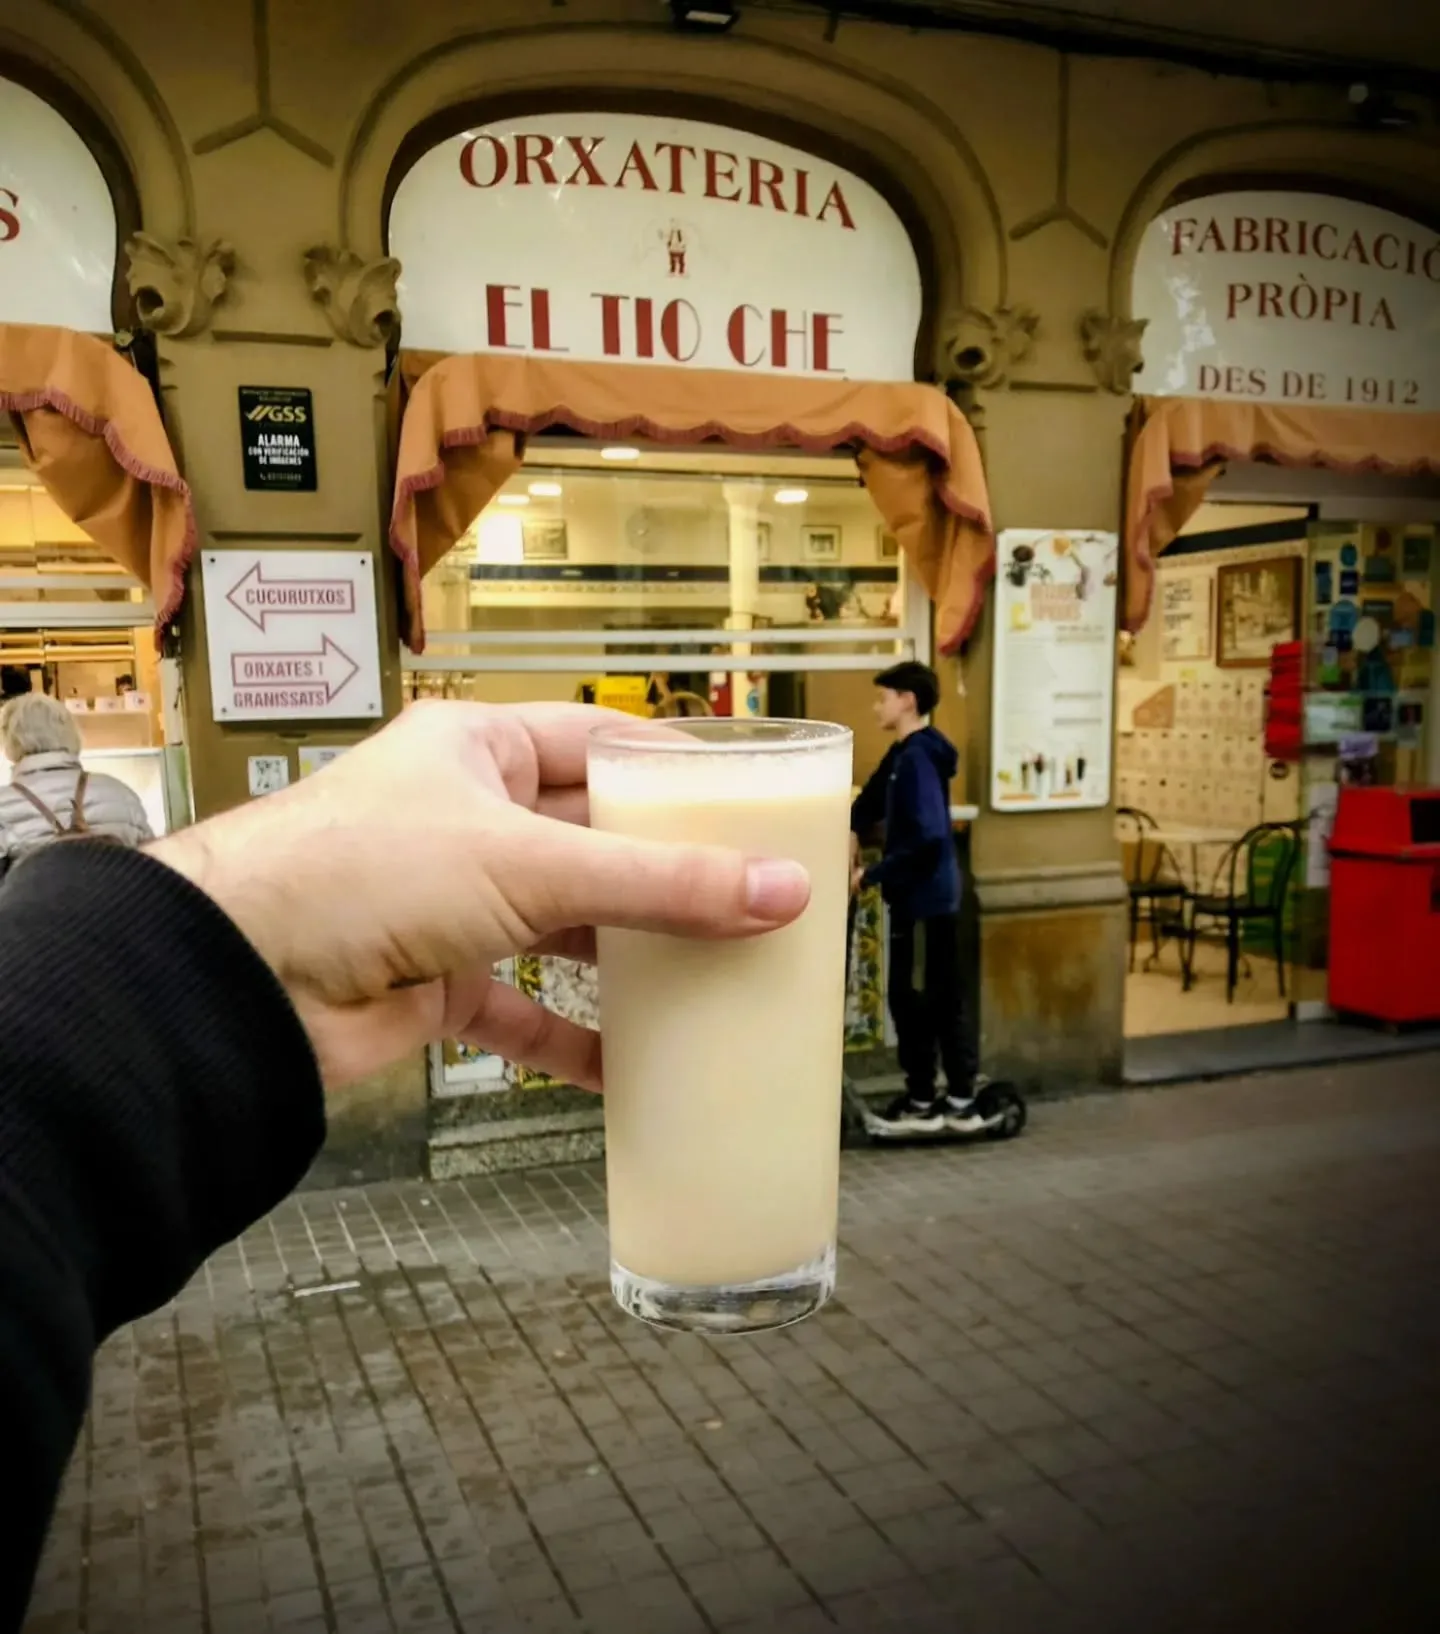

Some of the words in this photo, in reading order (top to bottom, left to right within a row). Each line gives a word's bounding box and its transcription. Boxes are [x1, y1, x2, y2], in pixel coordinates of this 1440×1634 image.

[459, 135, 857, 230] ORXATERIA
[1226, 273, 1397, 331] PRÒPIA
[485, 283, 570, 353] EL
[590, 292, 702, 363] TIO
[726, 303, 847, 373] CHE
[1199, 364, 1267, 396] DES
[1282, 369, 1327, 400] DE
[1345, 376, 1419, 404] 1912
[268, 405, 306, 423] GSS
[257, 433, 300, 448] ALARMA
[245, 589, 346, 606] CUCURUTXOS
[243, 660, 313, 679] ORXATES
[233, 690, 325, 709] GRANISSATS
